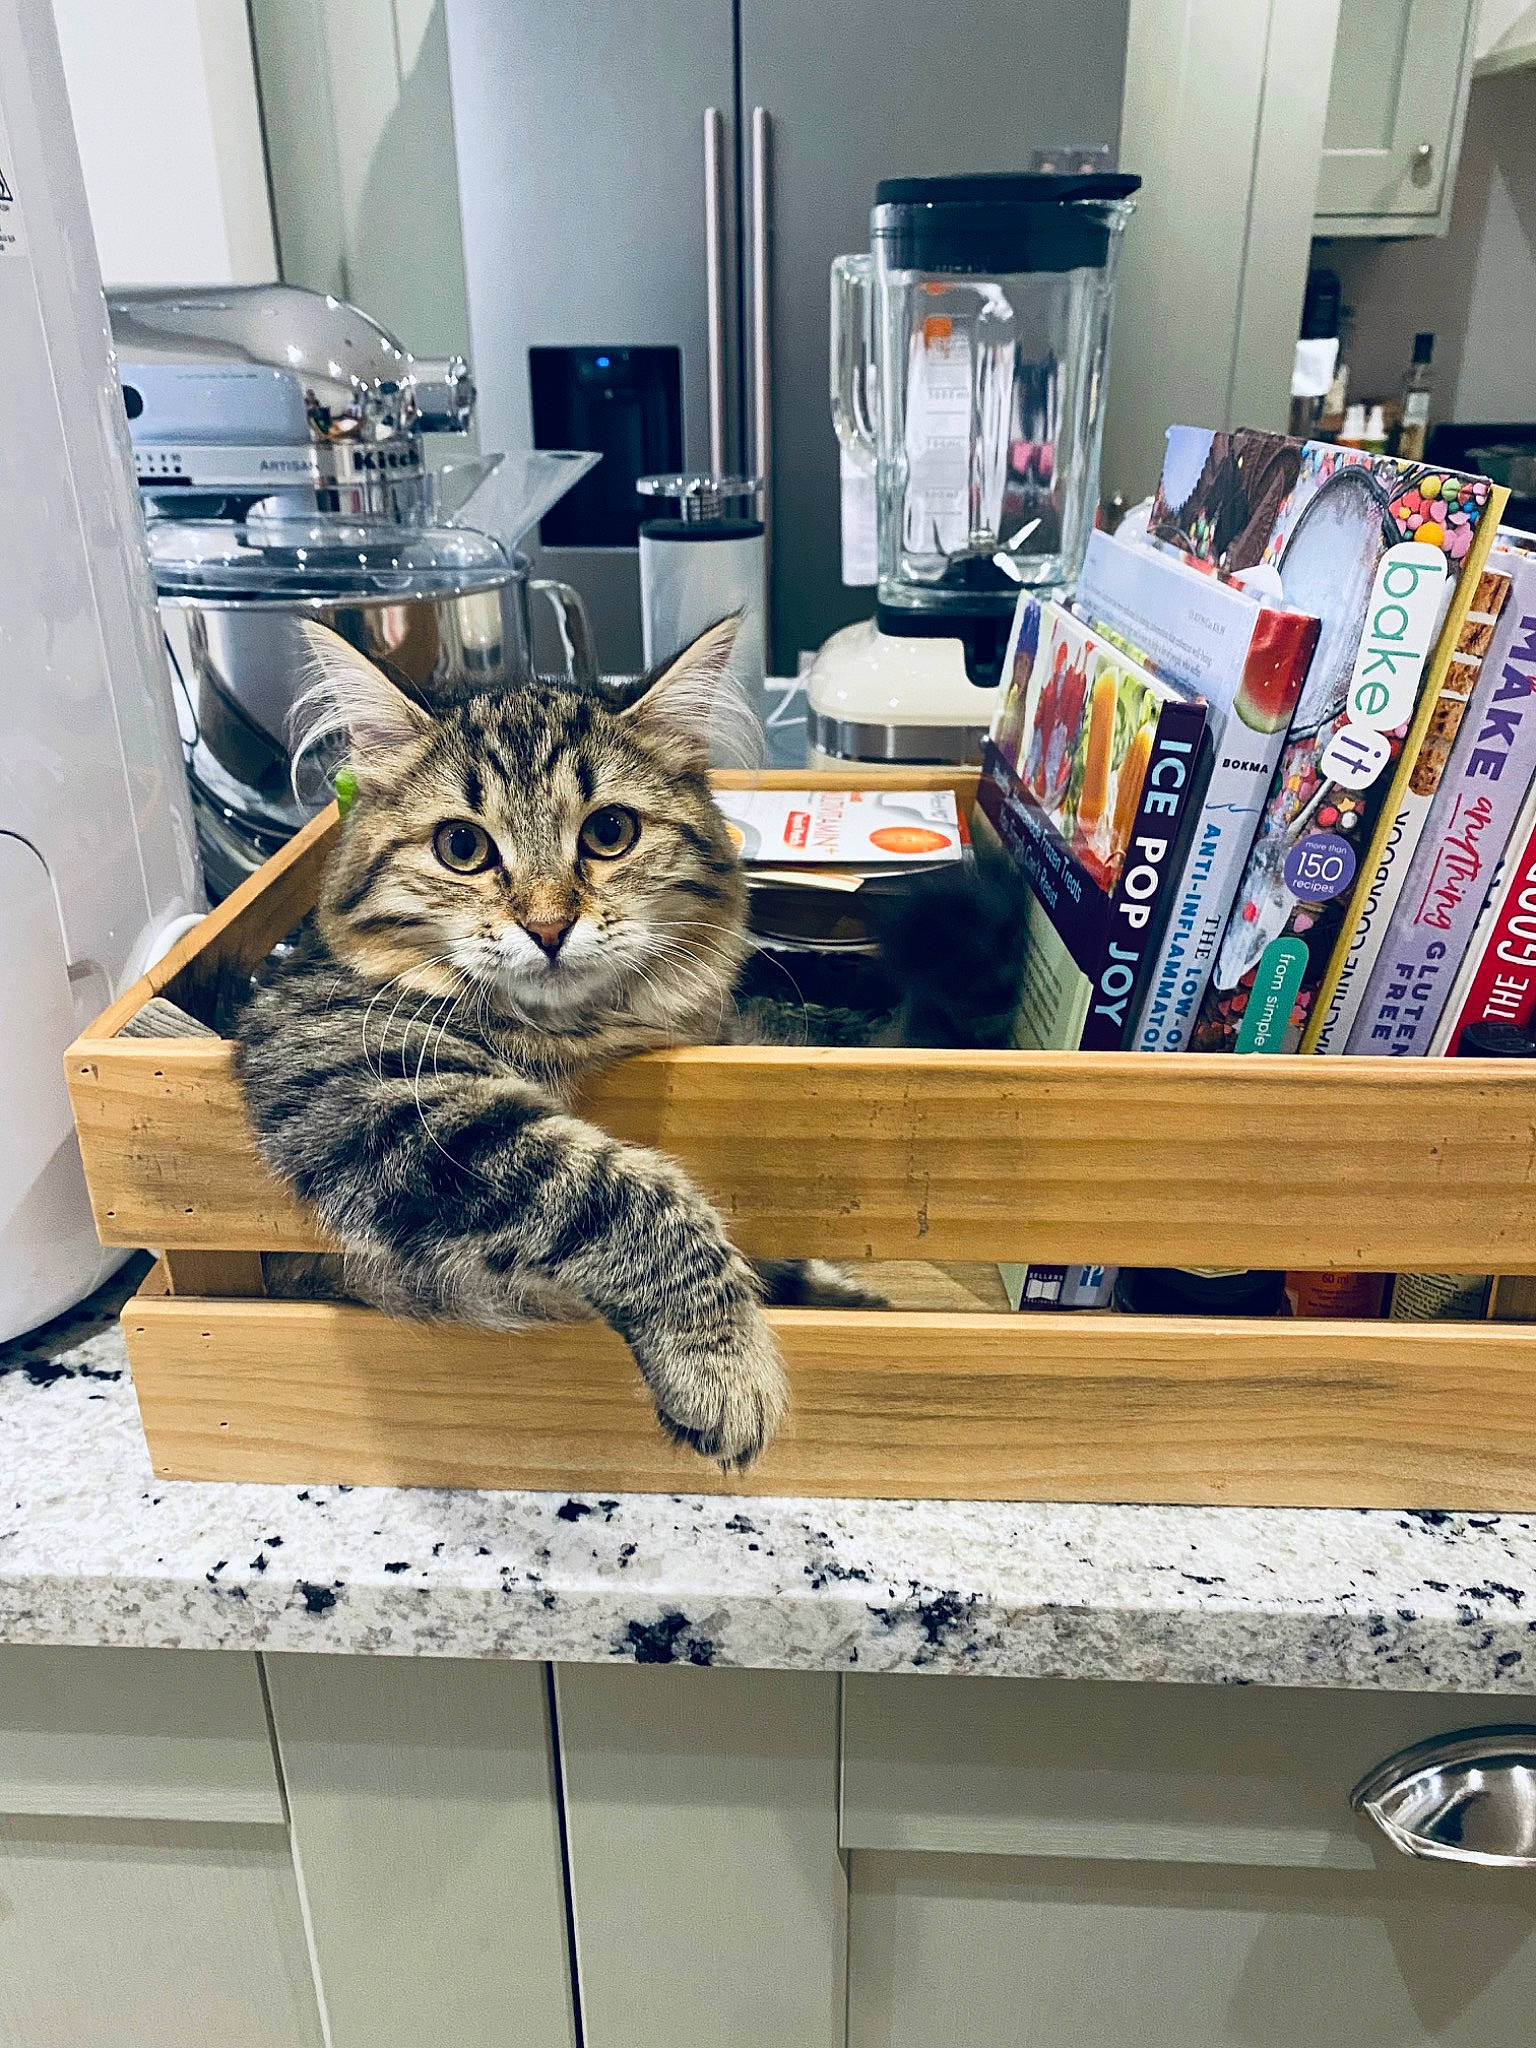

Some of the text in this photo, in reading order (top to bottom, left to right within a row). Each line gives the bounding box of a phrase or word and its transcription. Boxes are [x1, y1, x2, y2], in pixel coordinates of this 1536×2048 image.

[1331, 561, 1442, 775] bake it
[1143, 739, 1193, 816] ICE
[1222, 758, 1269, 775] BOKMA
[1039, 829, 1062, 874] Frozen
[1060, 856, 1082, 904] Treats
[1118, 835, 1168, 929] POP
[1292, 879, 1335, 893] recipes
[1297, 851, 1343, 882] 150
[1305, 842, 1347, 854] more than
[1194, 915, 1222, 960] THE
[1496, 862, 1536, 967] GO
[1094, 940, 1140, 1027] JOY
[1254, 953, 1296, 1047] from simple
[1371, 963, 1414, 1041] FREE
[1482, 973, 1529, 1019] THE
